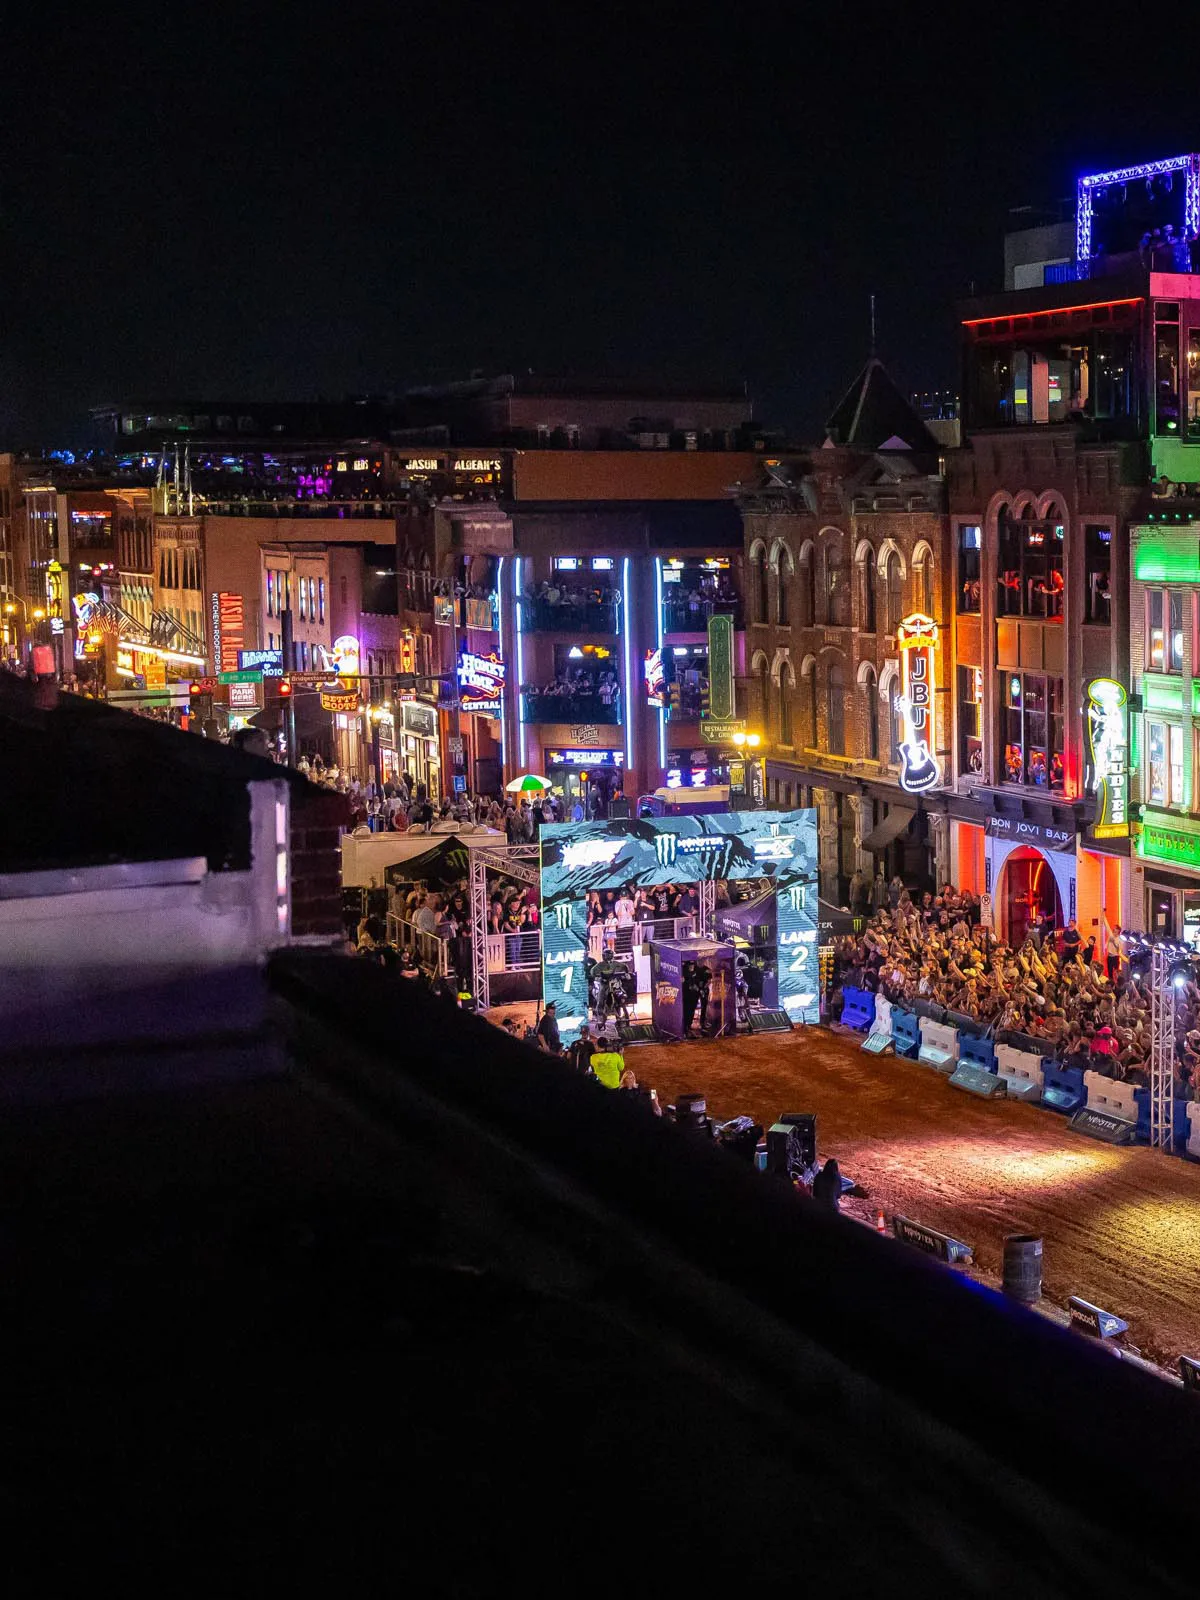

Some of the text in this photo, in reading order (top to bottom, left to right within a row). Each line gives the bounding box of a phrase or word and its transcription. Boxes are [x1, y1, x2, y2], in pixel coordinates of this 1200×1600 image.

[405, 459, 438, 471] JASON
[212, 593, 220, 625] KITCHEN
[219, 592, 244, 631] JASON
[462, 653, 505, 678] HONKY
[457, 667, 495, 692] TONK
[322, 693, 357, 702] BETTY
[911, 656, 930, 730] JBJ
[323, 701, 356, 710] BOOTS
[463, 701, 500, 711] CENTRAL
[991, 817, 1069, 841] BON JOVI BAR
[781, 930, 817, 945] LANE
[545, 949, 585, 965] LANE
[788, 946, 809, 972] 2
[560, 966, 574, 993] 1
[1087, 1115, 1118, 1130] MONSTER
